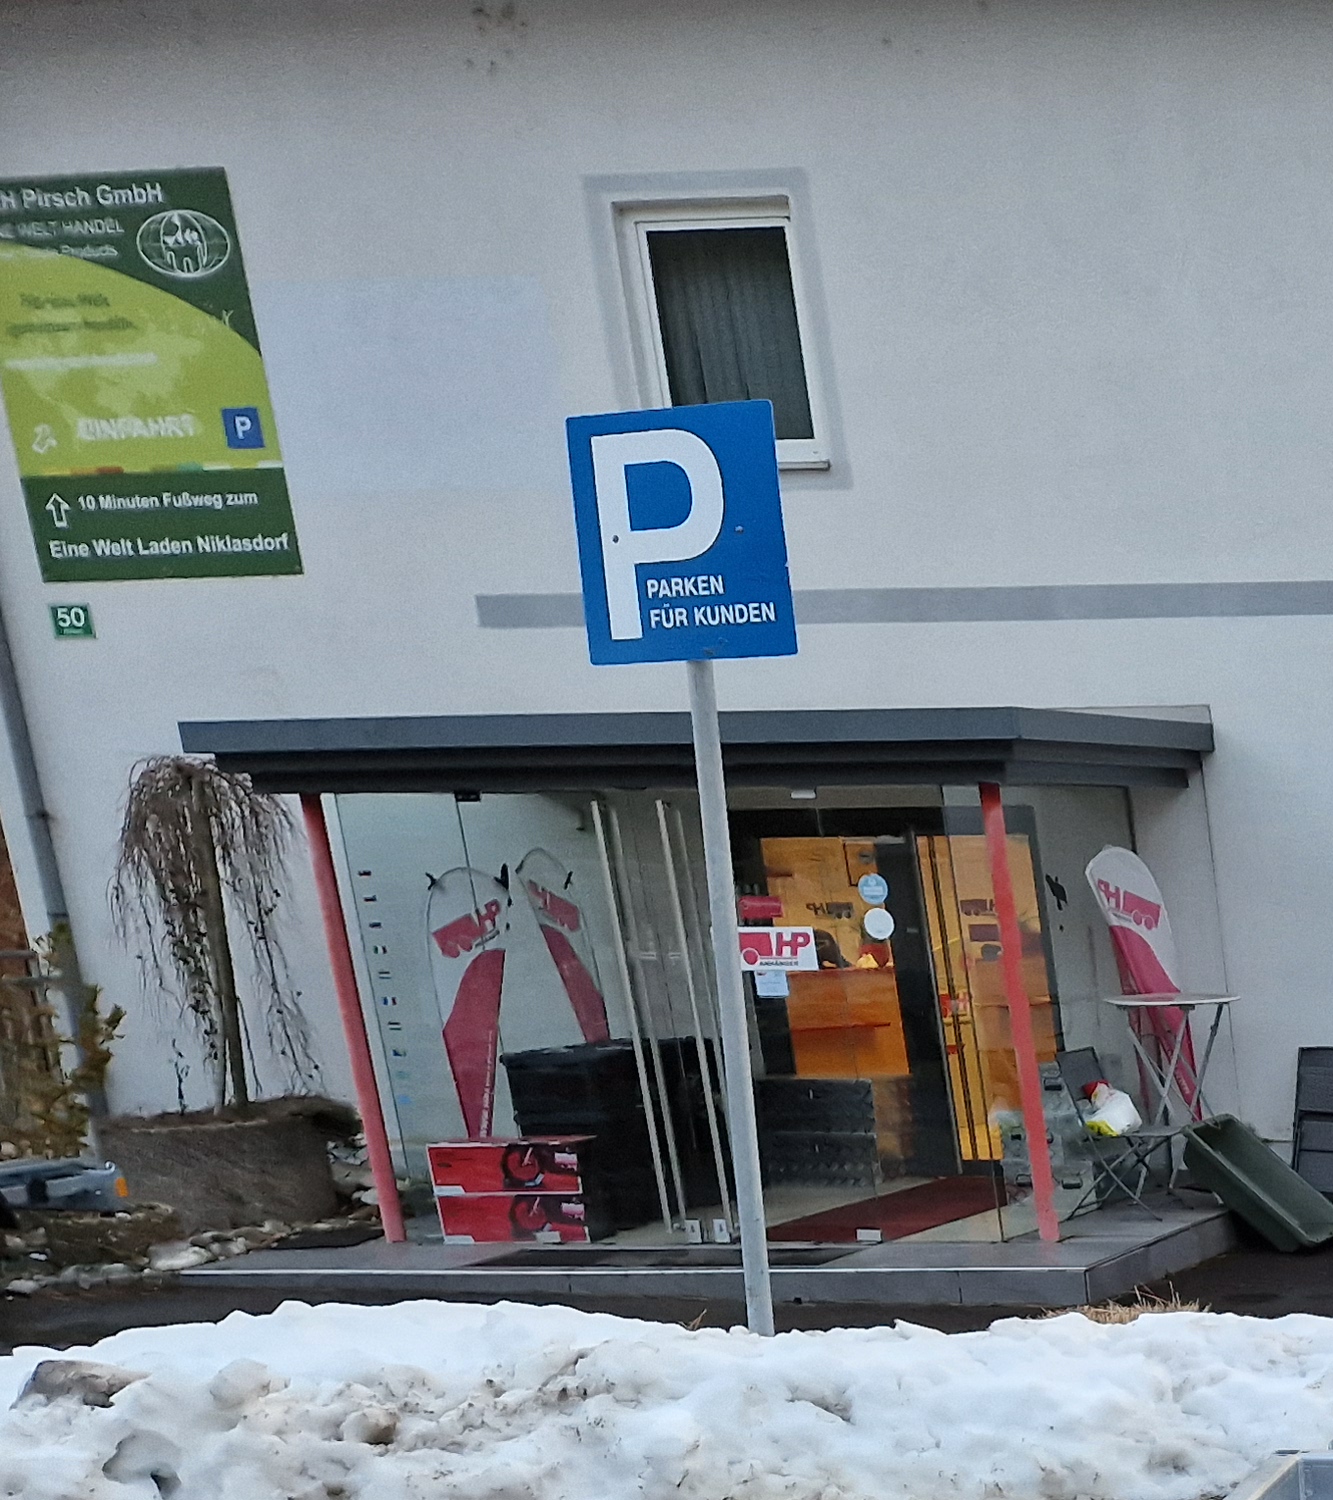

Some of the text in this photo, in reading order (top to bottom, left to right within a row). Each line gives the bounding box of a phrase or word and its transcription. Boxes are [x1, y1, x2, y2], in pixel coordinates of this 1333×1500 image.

[21, 186, 92, 209] Pirsch
[96, 182, 164, 206] GmbH
[61, 216, 125, 235] HANDEL
[235, 415, 252, 440] P
[78, 491, 258, 511] 10 Minuten Fußweg zum
[49, 532, 290, 559] Eine Welt Laden Niklasdorf
[590, 428, 725, 640] P
[646, 575, 725, 599] PARKEN
[57, 607, 85, 627] 50
[649, 602, 776, 629] FÜR KUNDEN
[776, 931, 811, 957] HP
